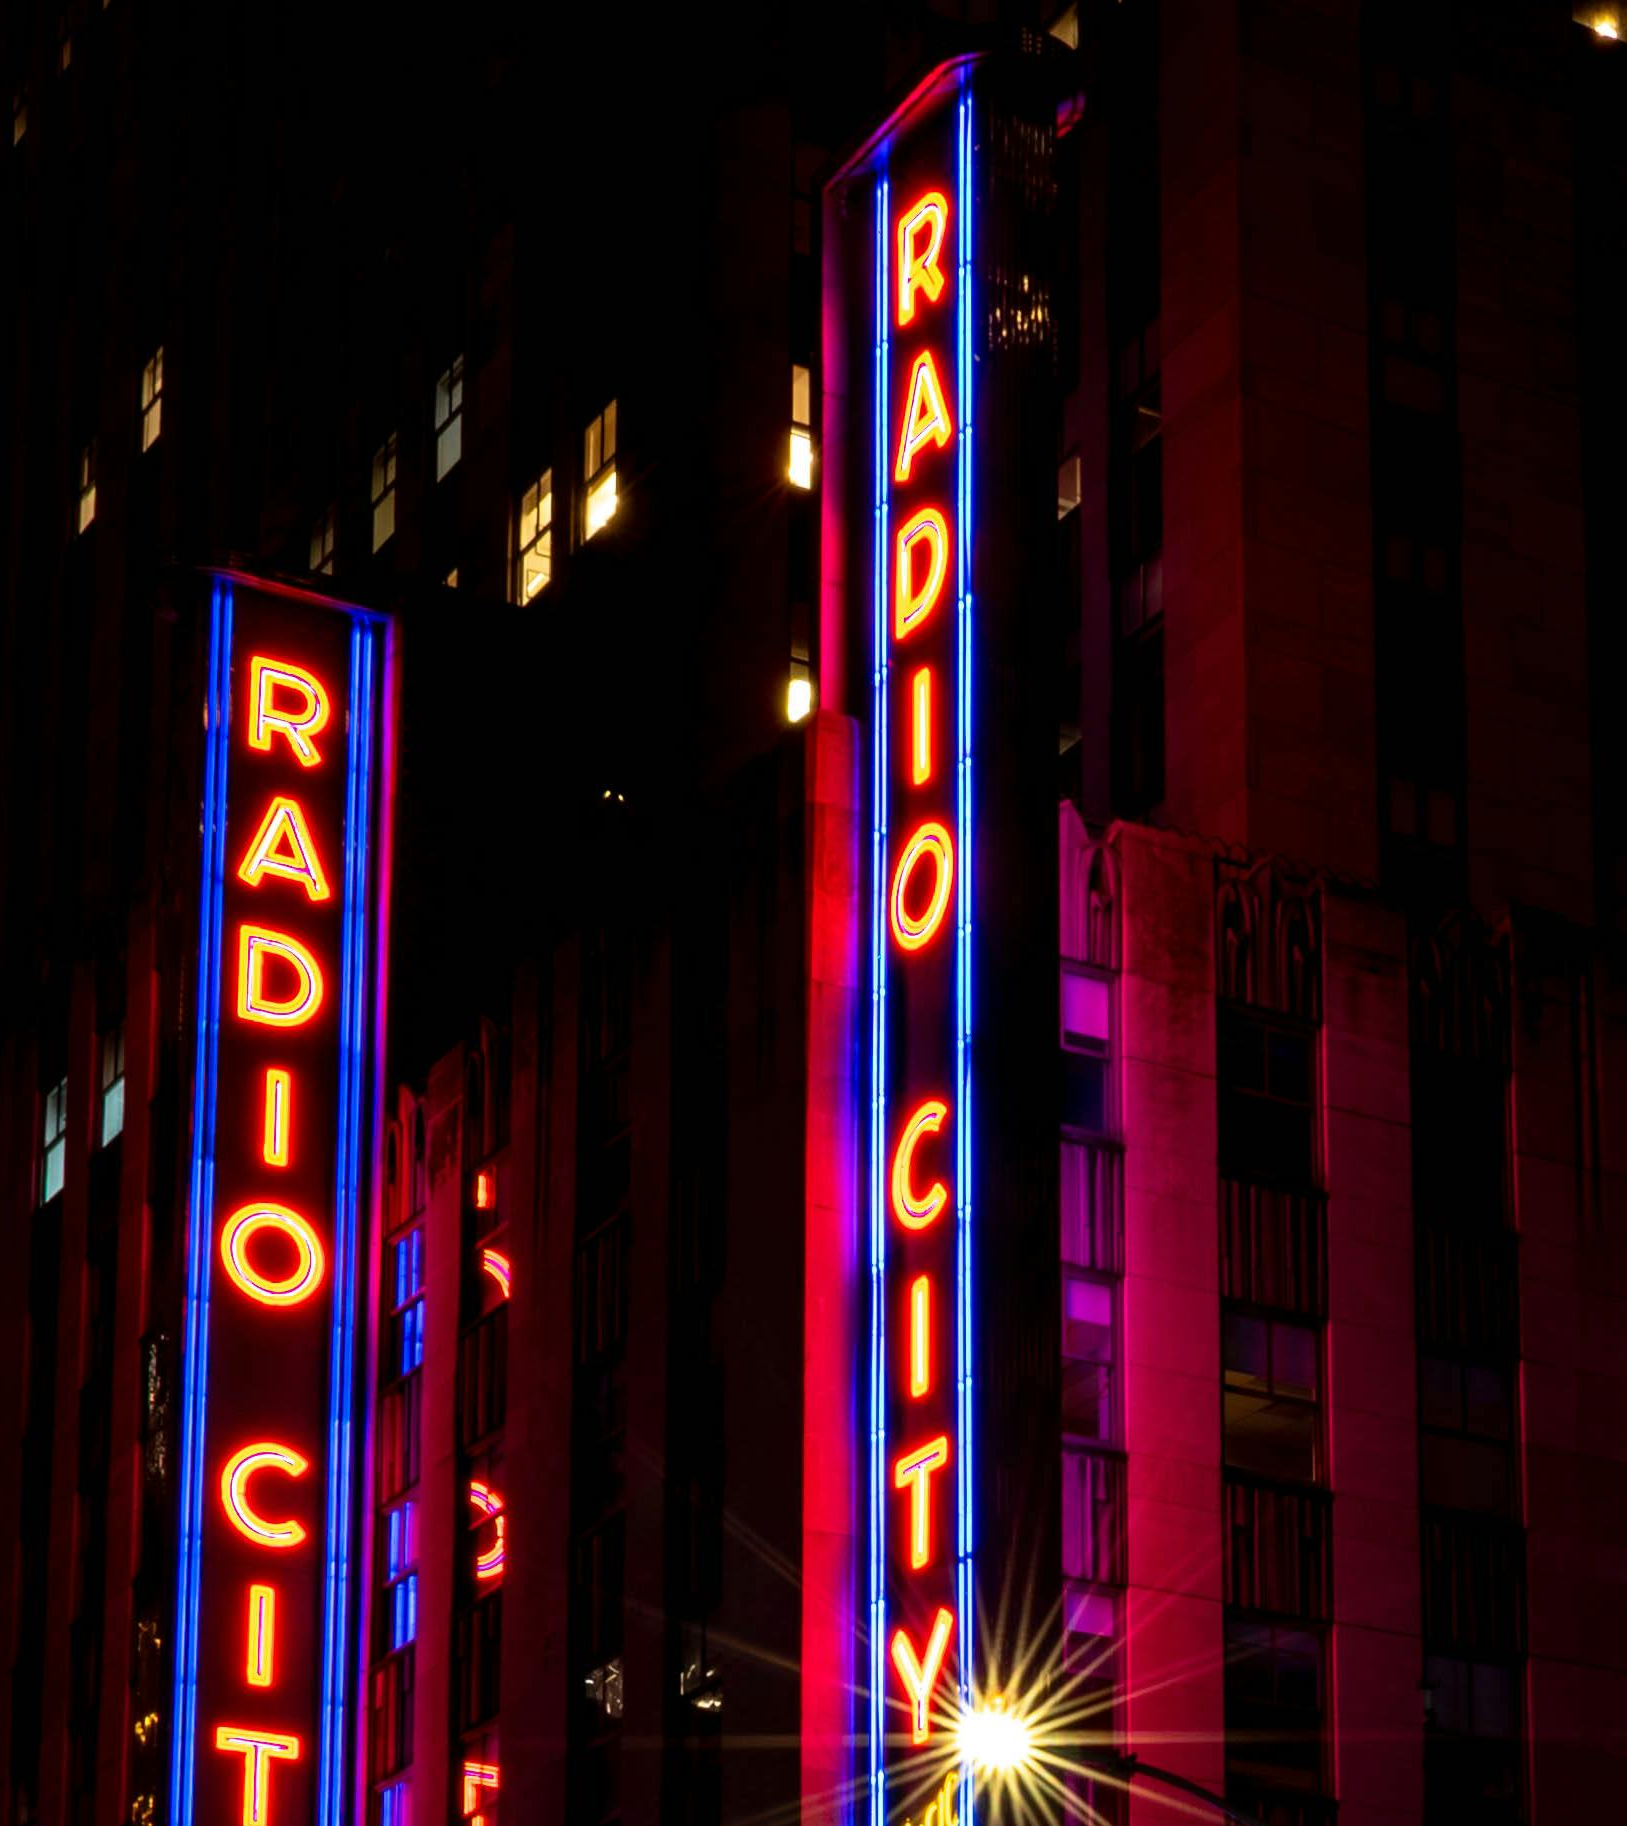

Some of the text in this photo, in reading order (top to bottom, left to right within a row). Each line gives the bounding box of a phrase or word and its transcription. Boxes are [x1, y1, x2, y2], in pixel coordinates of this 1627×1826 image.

[220, 654, 331, 1307] RADIO
[890, 190, 954, 1746] RADIO CITY
